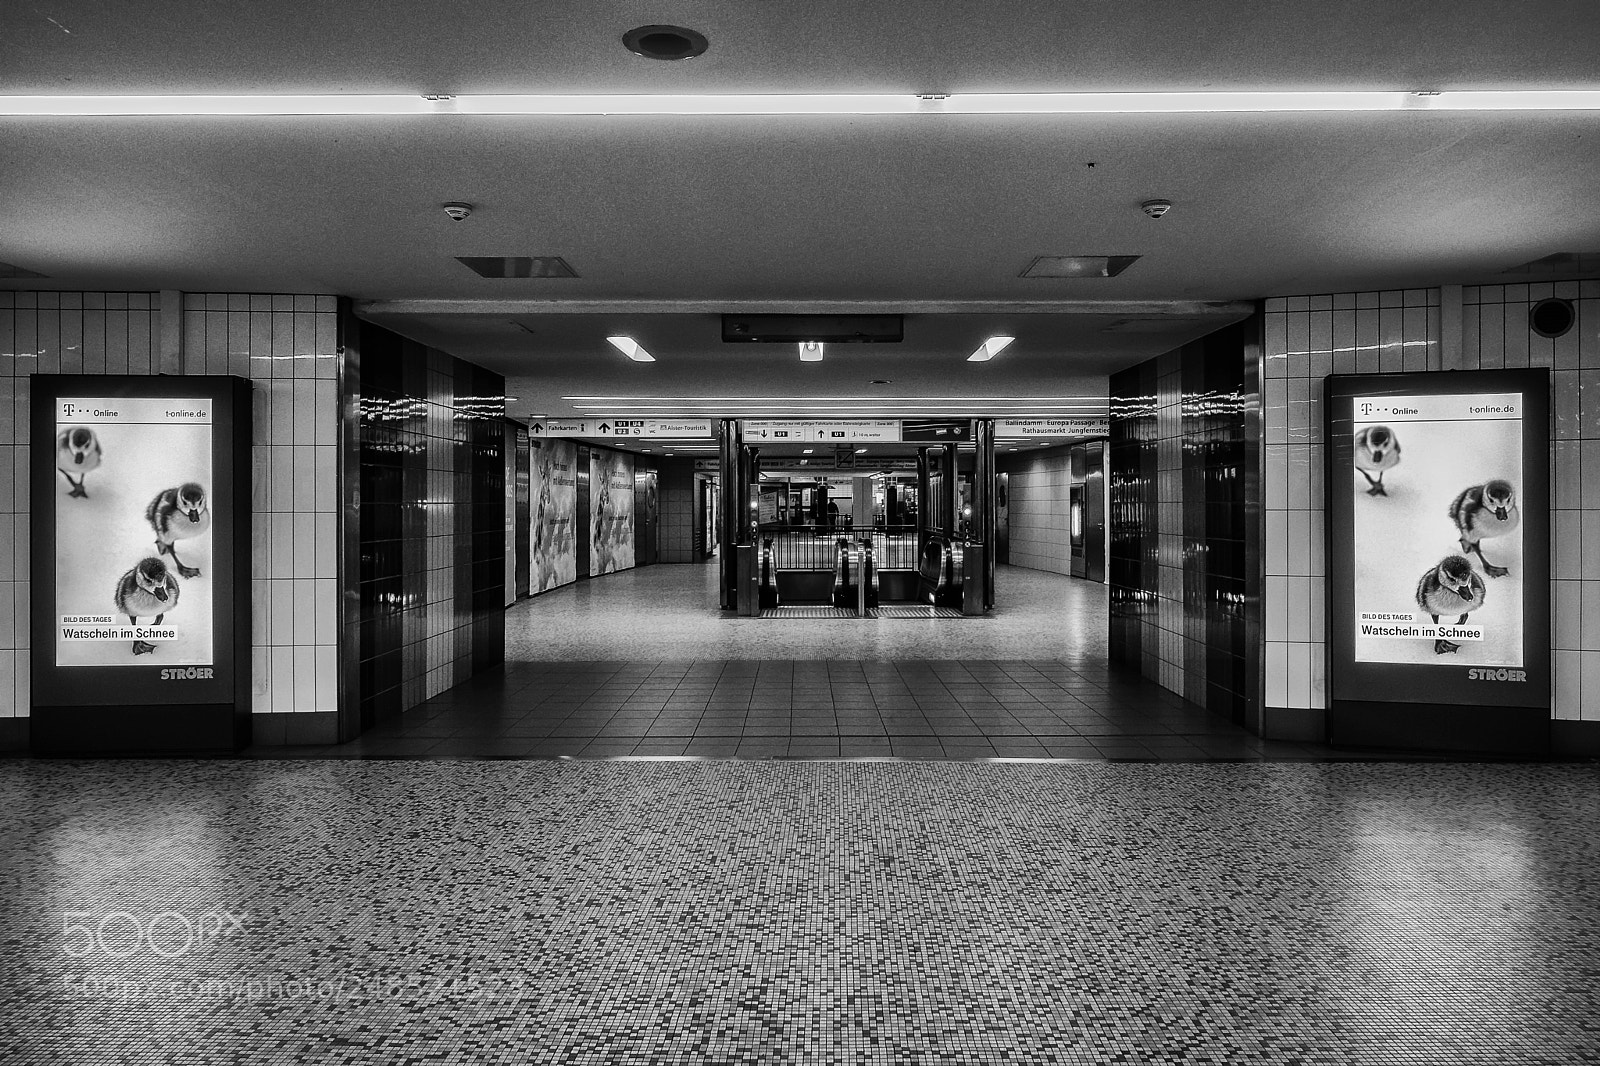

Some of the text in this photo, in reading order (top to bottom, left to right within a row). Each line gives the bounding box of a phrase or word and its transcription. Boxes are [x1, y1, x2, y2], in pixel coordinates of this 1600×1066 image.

[166, 410, 206, 418] t-online.de
[1470, 405, 1514, 414] t-online.de
[62, 628, 175, 639] Watscheln im Schnee
[1361, 625, 1481, 638] Watscheln im Schnee
[160, 667, 214, 680] STRÖER
[1468, 668, 1526, 682] STRÖER
